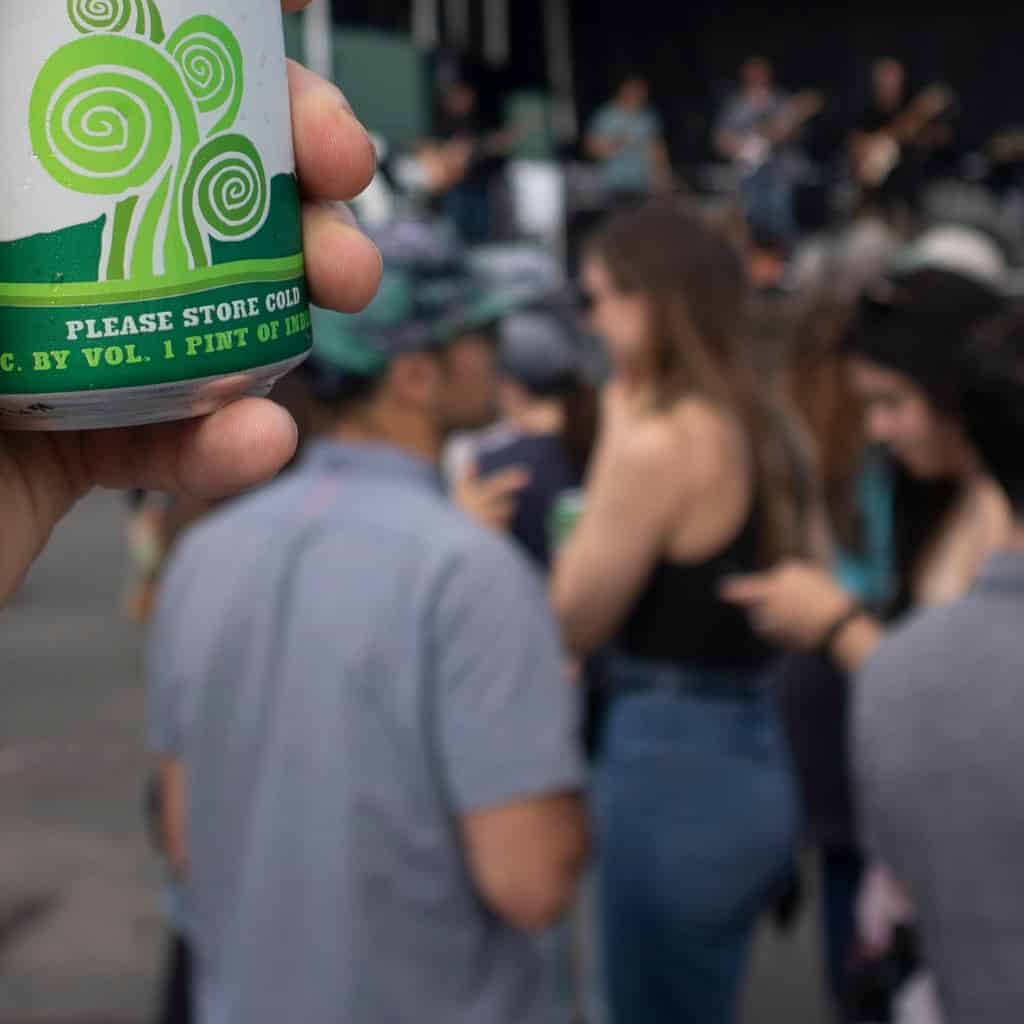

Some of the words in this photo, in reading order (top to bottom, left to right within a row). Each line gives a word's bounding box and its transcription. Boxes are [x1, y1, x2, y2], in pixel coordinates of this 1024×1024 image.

[66, 311, 173, 340] PLEASE
[183, 297, 259, 327] STORE
[266, 287, 300, 312] COLD
[33, 350, 71, 371] BY
[82, 345, 151, 368] VOL.
[163, 340, 175, 359] 1
[185, 327, 249, 356] PINT
[257, 320, 280, 343] OF
